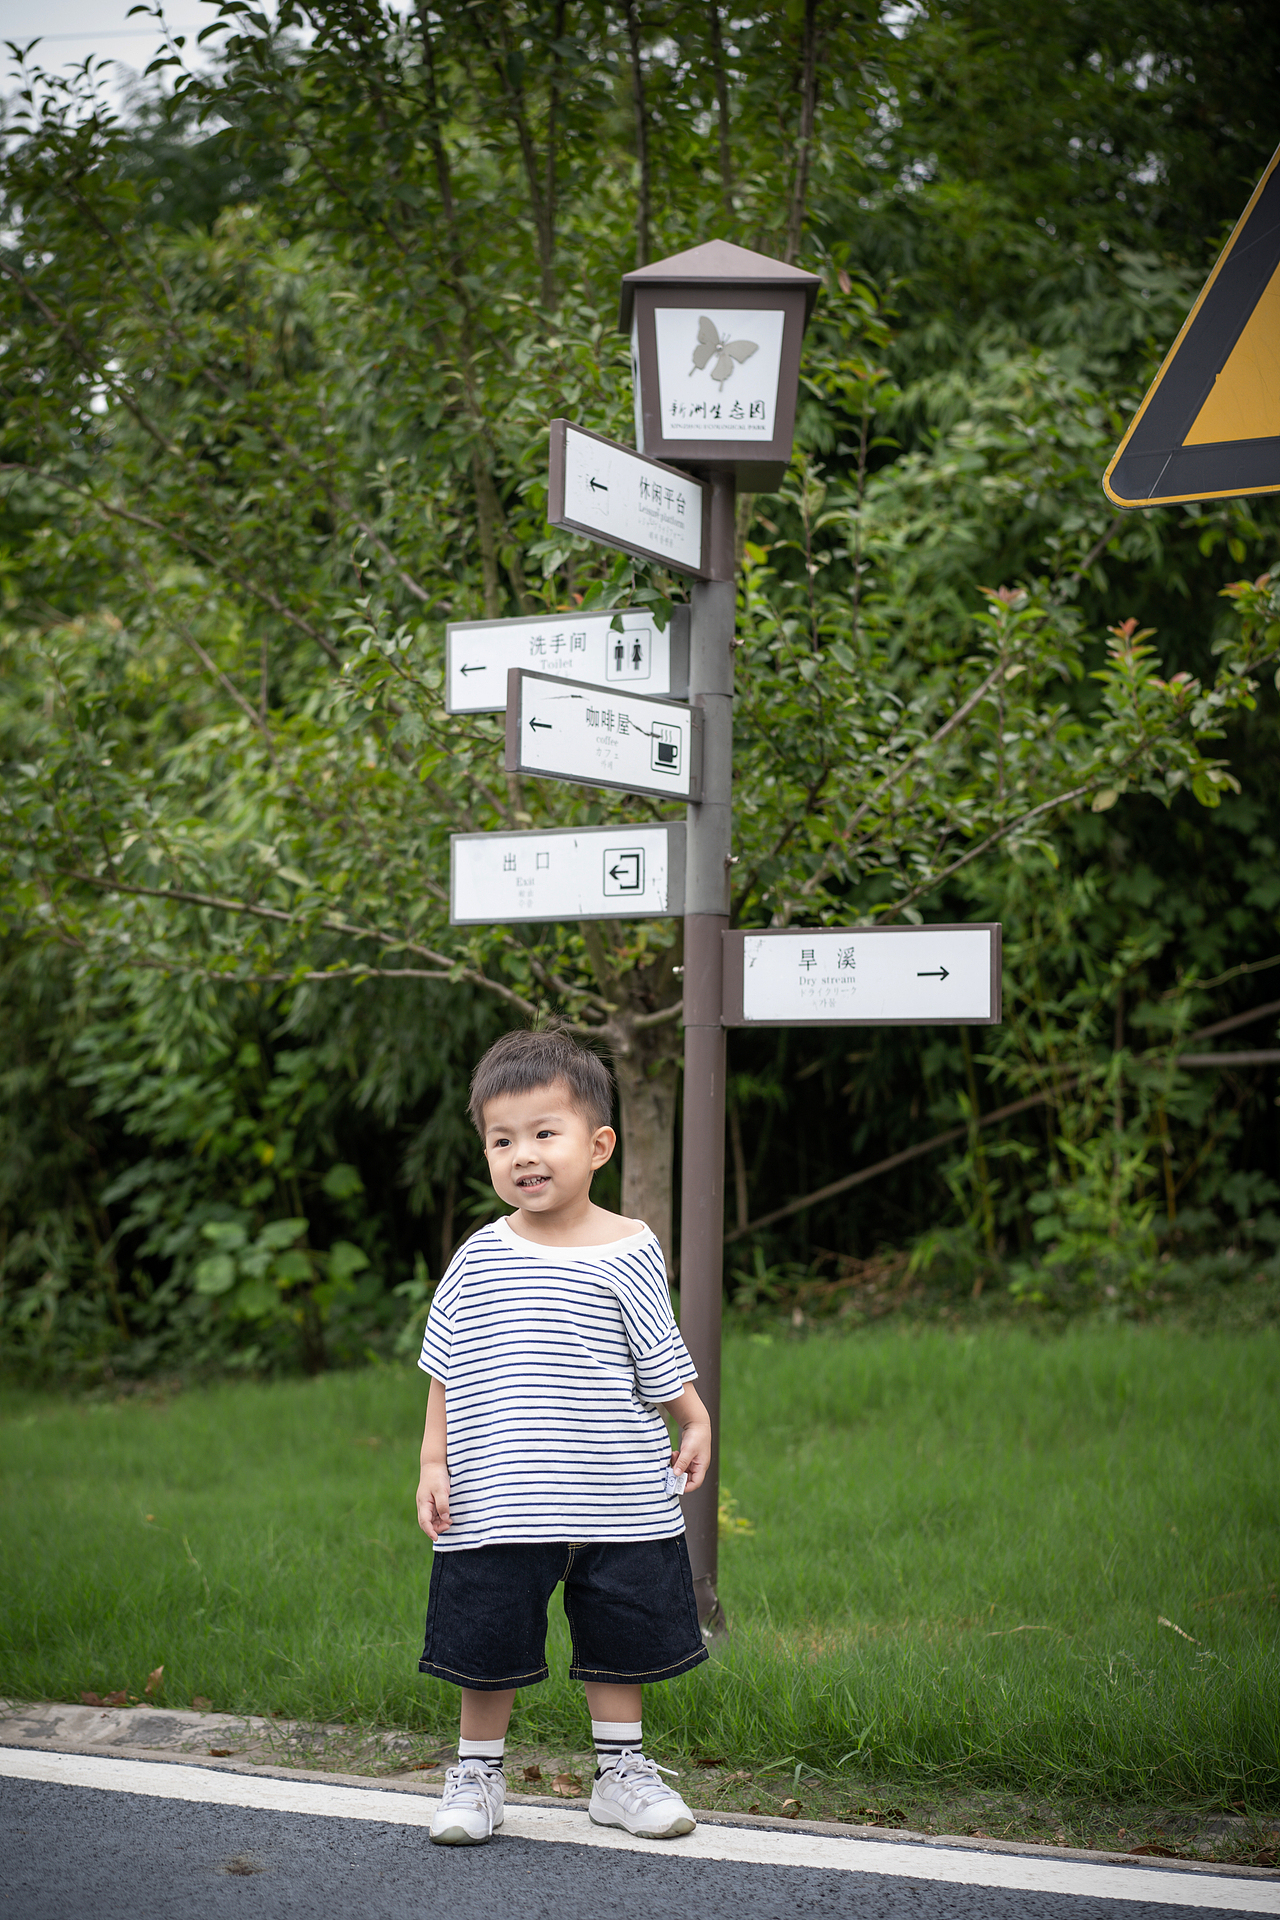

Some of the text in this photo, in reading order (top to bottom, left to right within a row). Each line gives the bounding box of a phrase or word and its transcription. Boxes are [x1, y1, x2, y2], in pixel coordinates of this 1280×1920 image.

[639, 475, 686, 516] 休闲平台
[529, 632, 587, 656] 洗手间
[540, 658, 573, 670] Toilet
[585, 705, 630, 736] 咖啡屋
[595, 735, 619, 747] coffee
[503, 852, 549, 872] 出口
[516, 877, 535, 887] Exit
[798, 946, 857, 972] 旱溪
[799, 975, 856, 987] Dry stream
